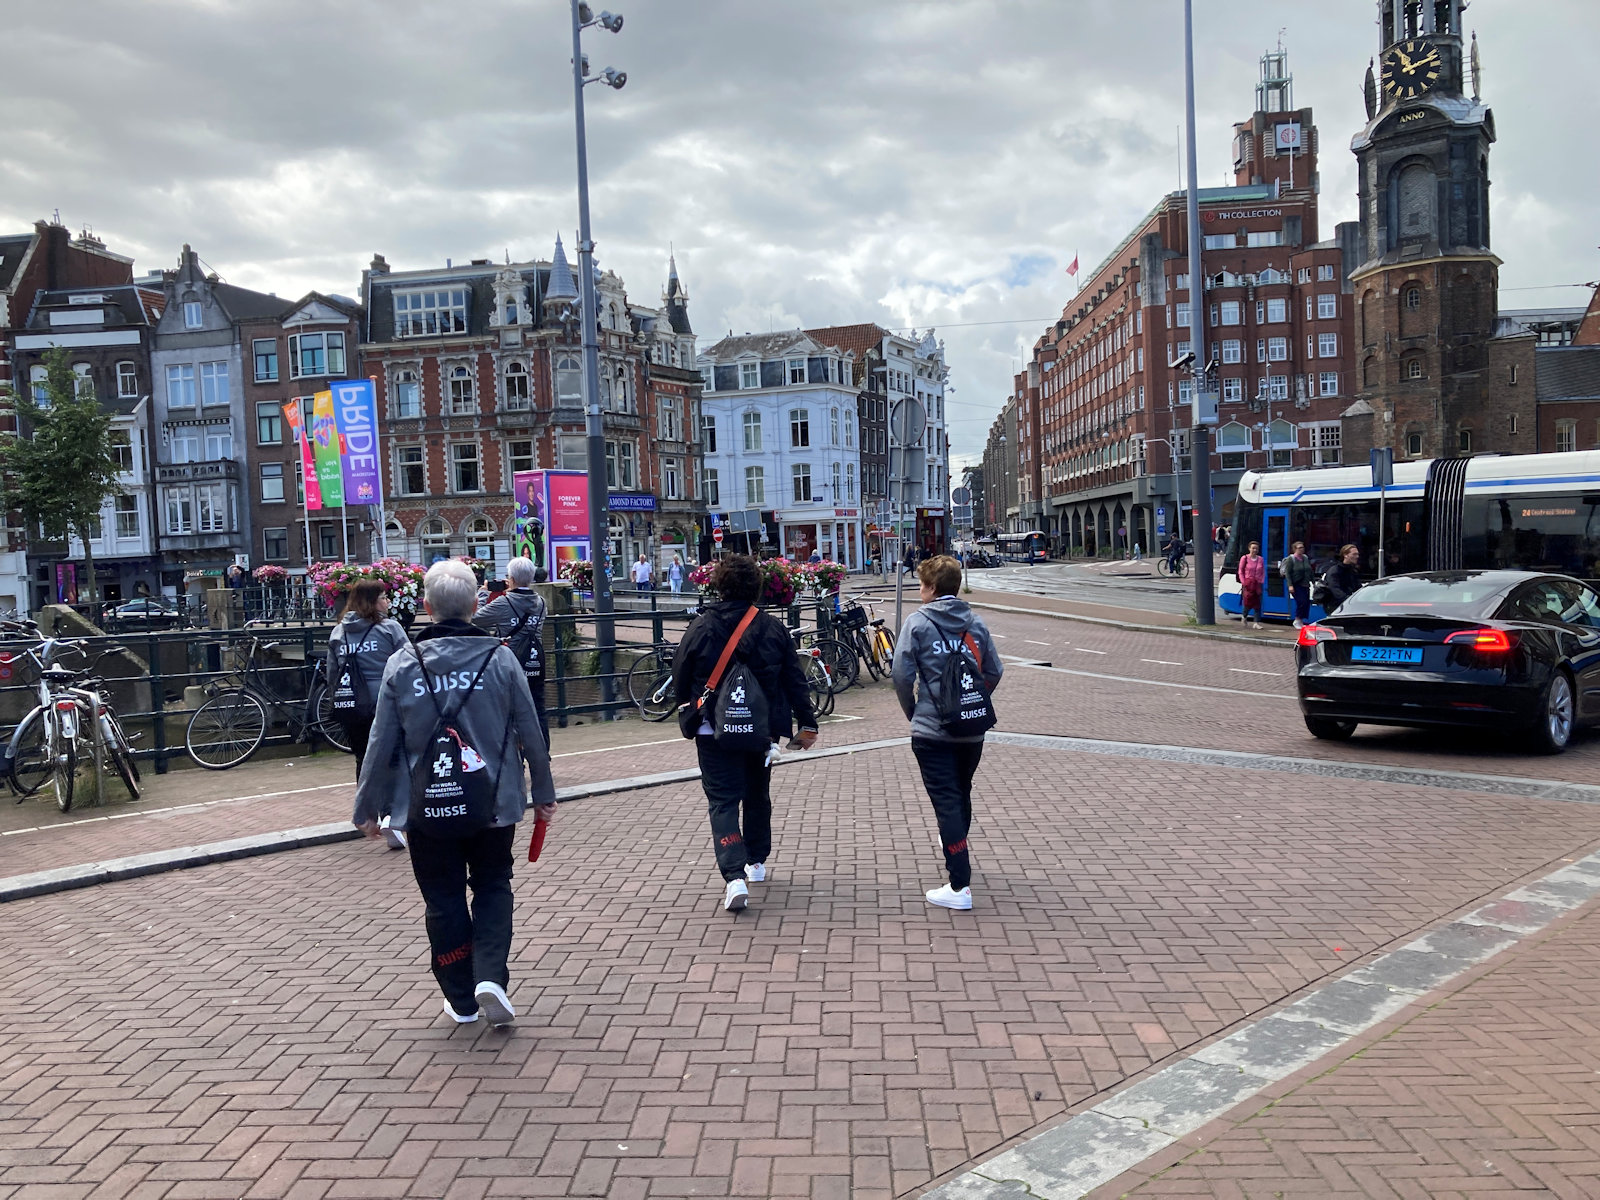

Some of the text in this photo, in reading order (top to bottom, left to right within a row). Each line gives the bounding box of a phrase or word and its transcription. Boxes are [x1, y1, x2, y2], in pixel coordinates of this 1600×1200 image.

[1400, 111, 1425, 123] ANNO
[1231, 209, 1282, 219] COLLECTION
[630, 498, 654, 506] FACTORY
[1522, 509, 1531, 517] 24
[339, 641, 378, 656] SUISSE
[1360, 648, 1413, 660] S-221-TN
[334, 700, 355, 709] SUISSE
[961, 708, 987, 720] SUISSE
[723, 723, 754, 733] SUISSE
[424, 804, 467, 818] SUISSE
